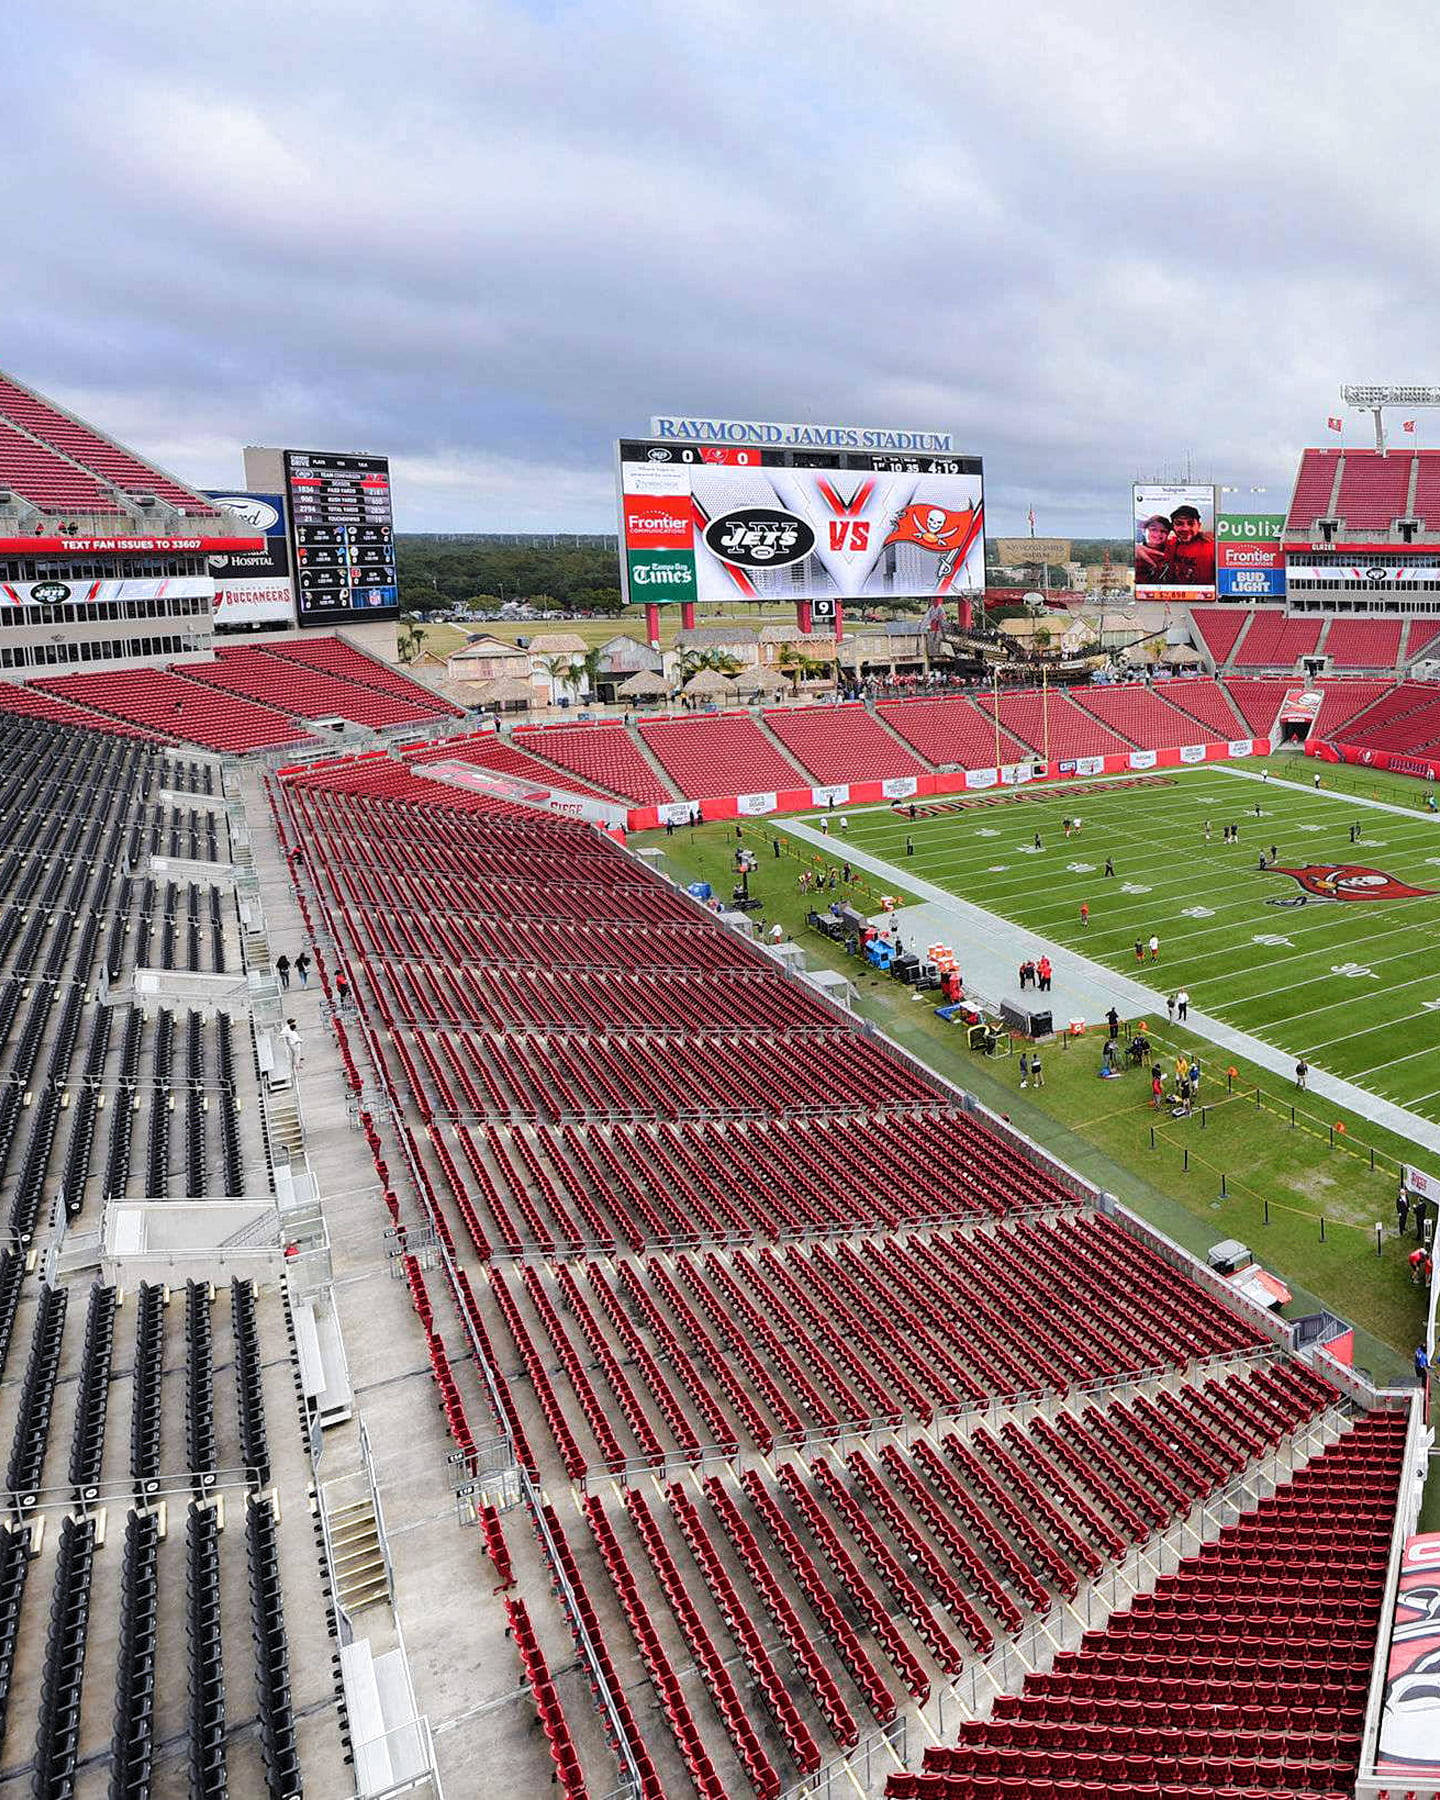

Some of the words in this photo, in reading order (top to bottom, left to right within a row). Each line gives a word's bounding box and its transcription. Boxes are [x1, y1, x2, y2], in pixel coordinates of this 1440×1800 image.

[657, 419, 782, 442] RAYMOND
[786, 426, 858, 448] JAMES
[862, 431, 951, 451] STADIUM
[681, 450, 694, 462] 0
[737, 453, 748, 464] 0
[890, 463, 903, 472] 10
[906, 464, 919, 473] 35
[928, 463, 959, 474] 4:19
[629, 515, 689, 528] Frontier
[1217, 520, 1283, 538] Publix
[720, 527, 798, 546] JETS
[829, 520, 871, 552] VS
[62, 540, 91, 550] TEXT
[93, 540, 116, 550] FAN
[118, 540, 154, 550] ISSUES
[156, 540, 171, 550] TO
[172, 539, 201, 550] 33607
[231, 556, 274, 566] HOSPITAL
[1225, 549, 1276, 562] Frontier
[633, 564, 692, 585] Times
[1237, 572, 1265, 581] BUD
[1231, 581, 1271, 592] LIGHT
[226, 588, 290, 606] BUCCANEERS
[818, 601, 829, 614] 9
[1331, 962, 1371, 978] 30
